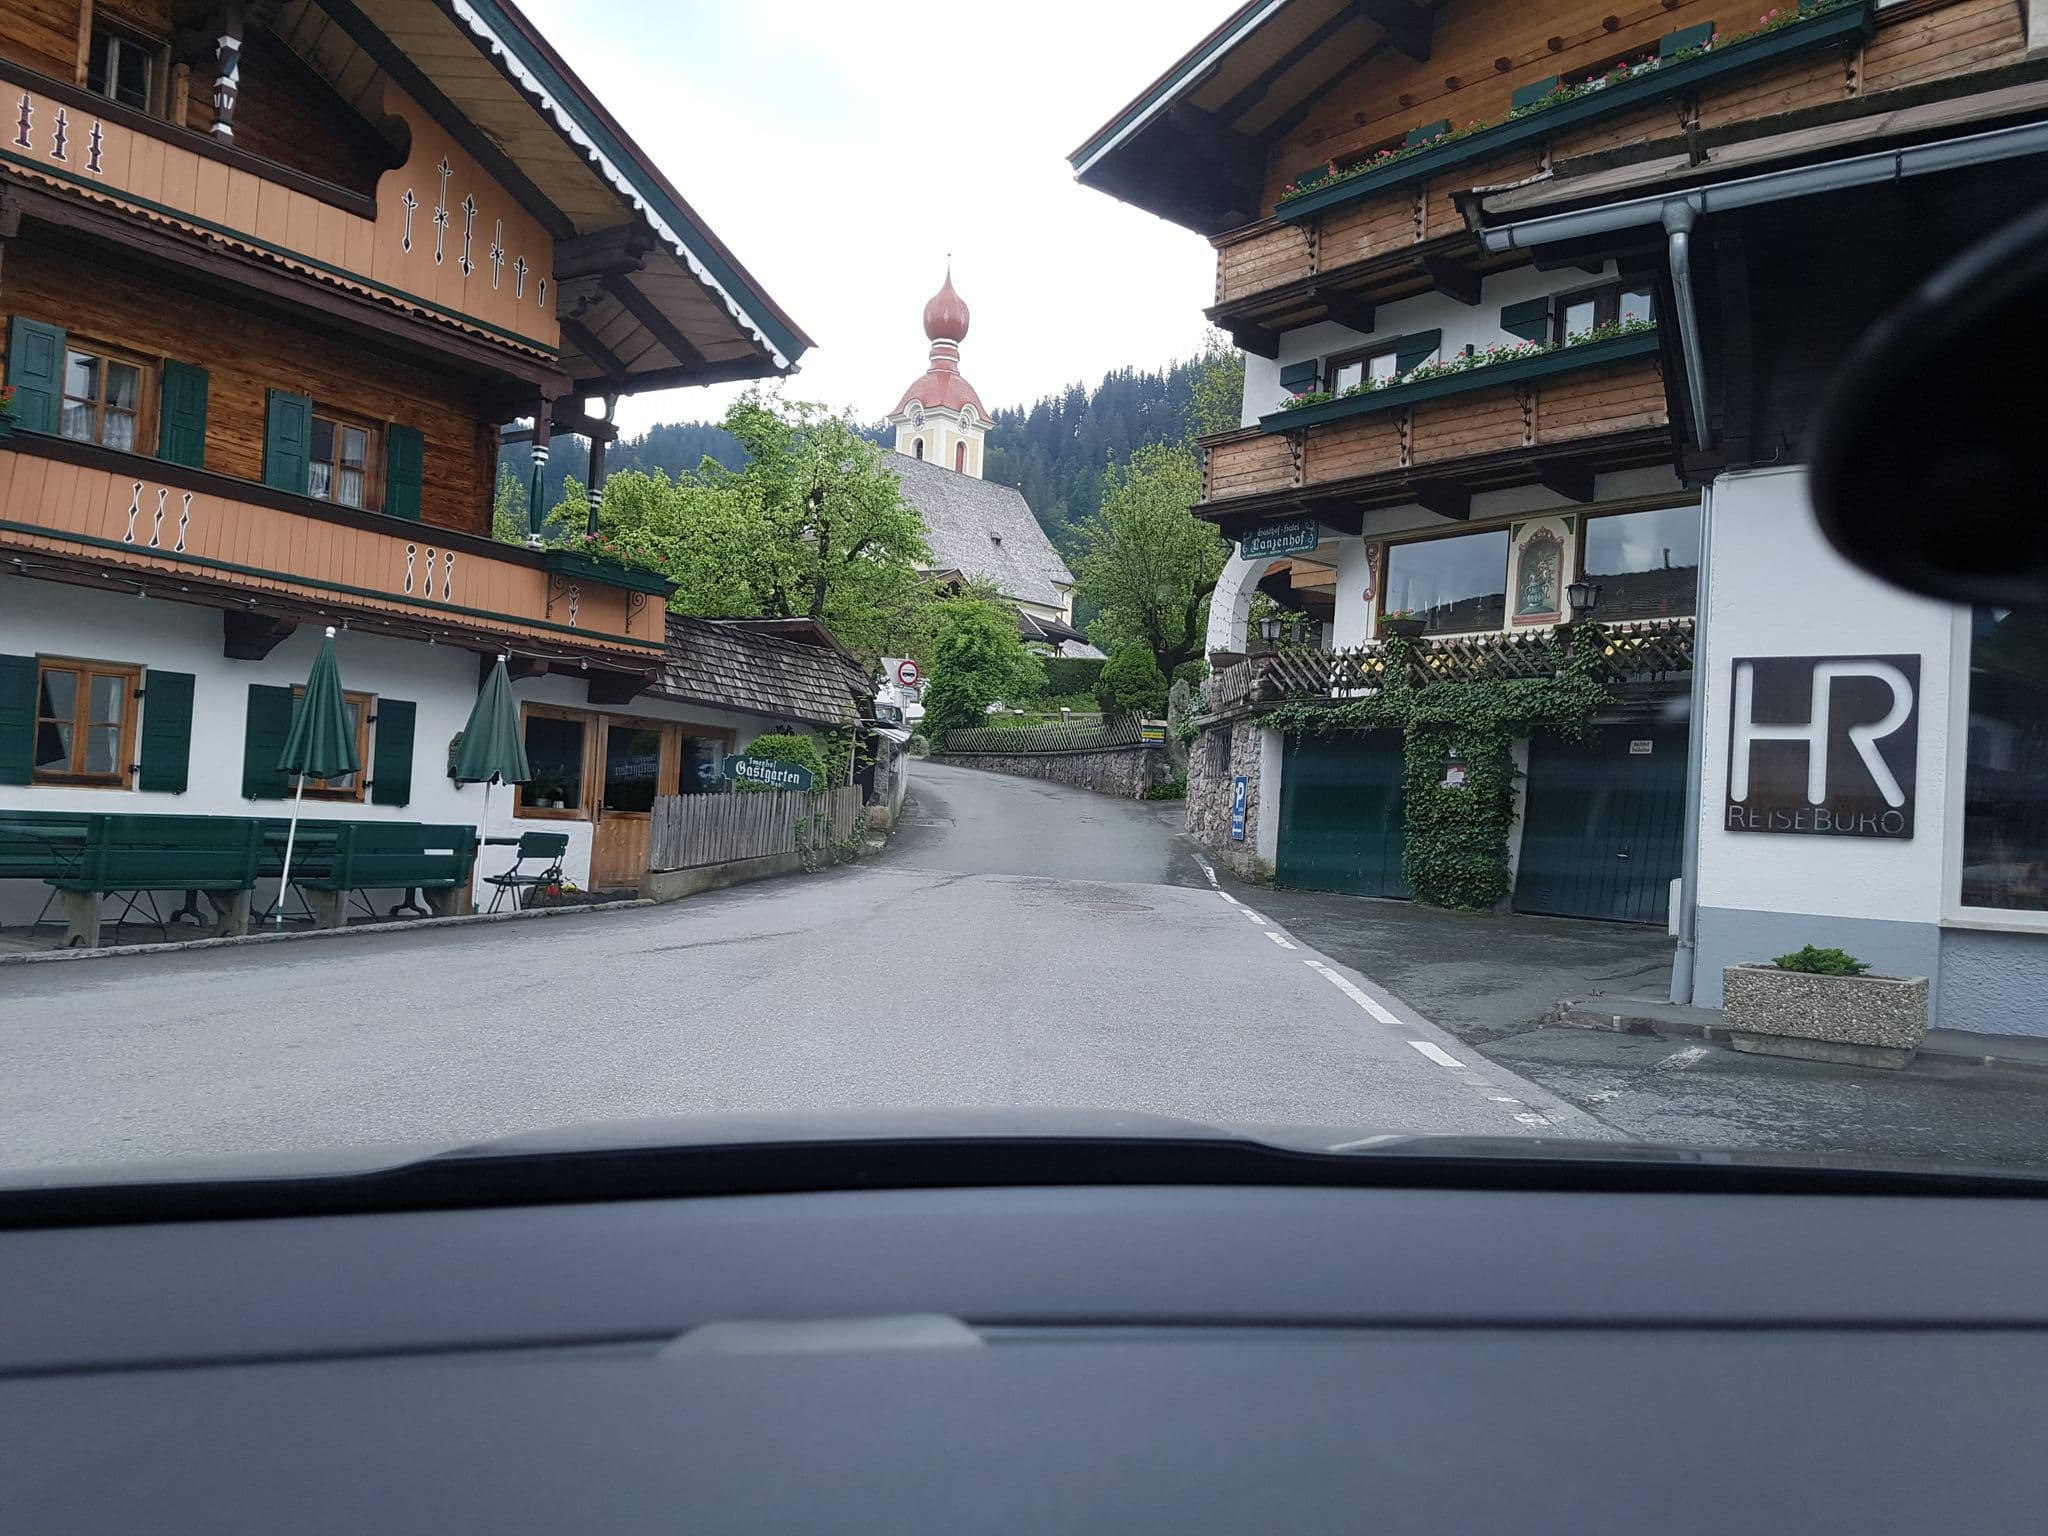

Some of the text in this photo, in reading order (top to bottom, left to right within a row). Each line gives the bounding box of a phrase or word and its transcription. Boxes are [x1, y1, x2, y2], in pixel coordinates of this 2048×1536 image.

[1250, 530, 1306, 553] Lanzenhof
[1730, 659, 1914, 808] HR
[735, 760, 800, 785] Gastgarten
[1235, 781, 1245, 809] P
